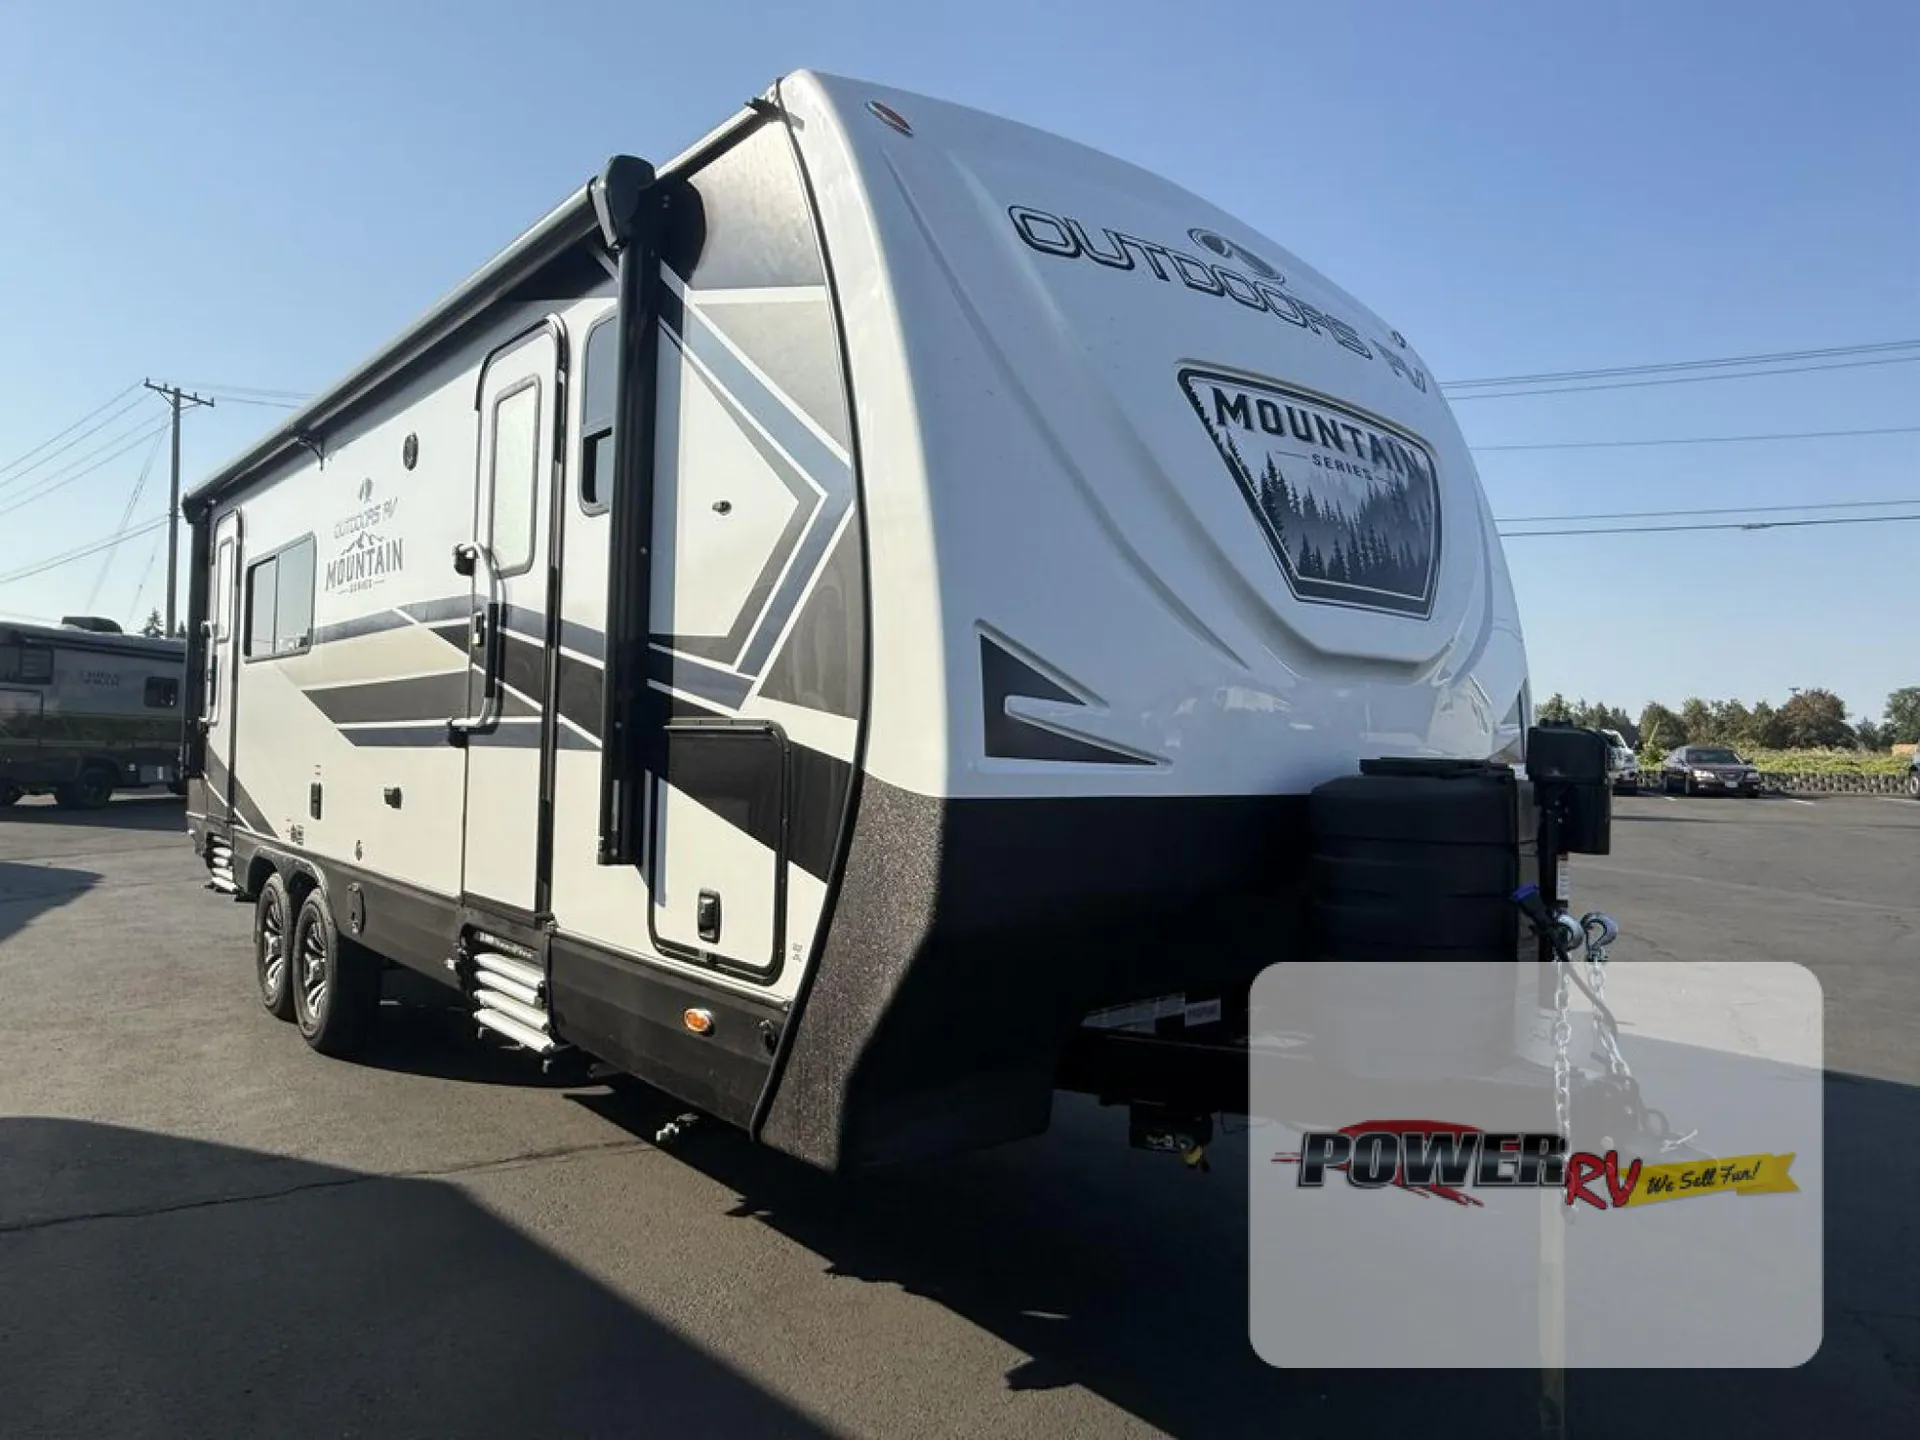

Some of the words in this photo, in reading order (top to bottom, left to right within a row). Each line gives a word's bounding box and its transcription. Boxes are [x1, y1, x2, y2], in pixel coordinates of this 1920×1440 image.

[1008, 205, 1374, 361] OUTDOORS
[1212, 386, 1426, 484] MOUNTAIN
[1311, 453, 1374, 481] SERIES
[325, 537, 404, 591] MOUNTAIN
